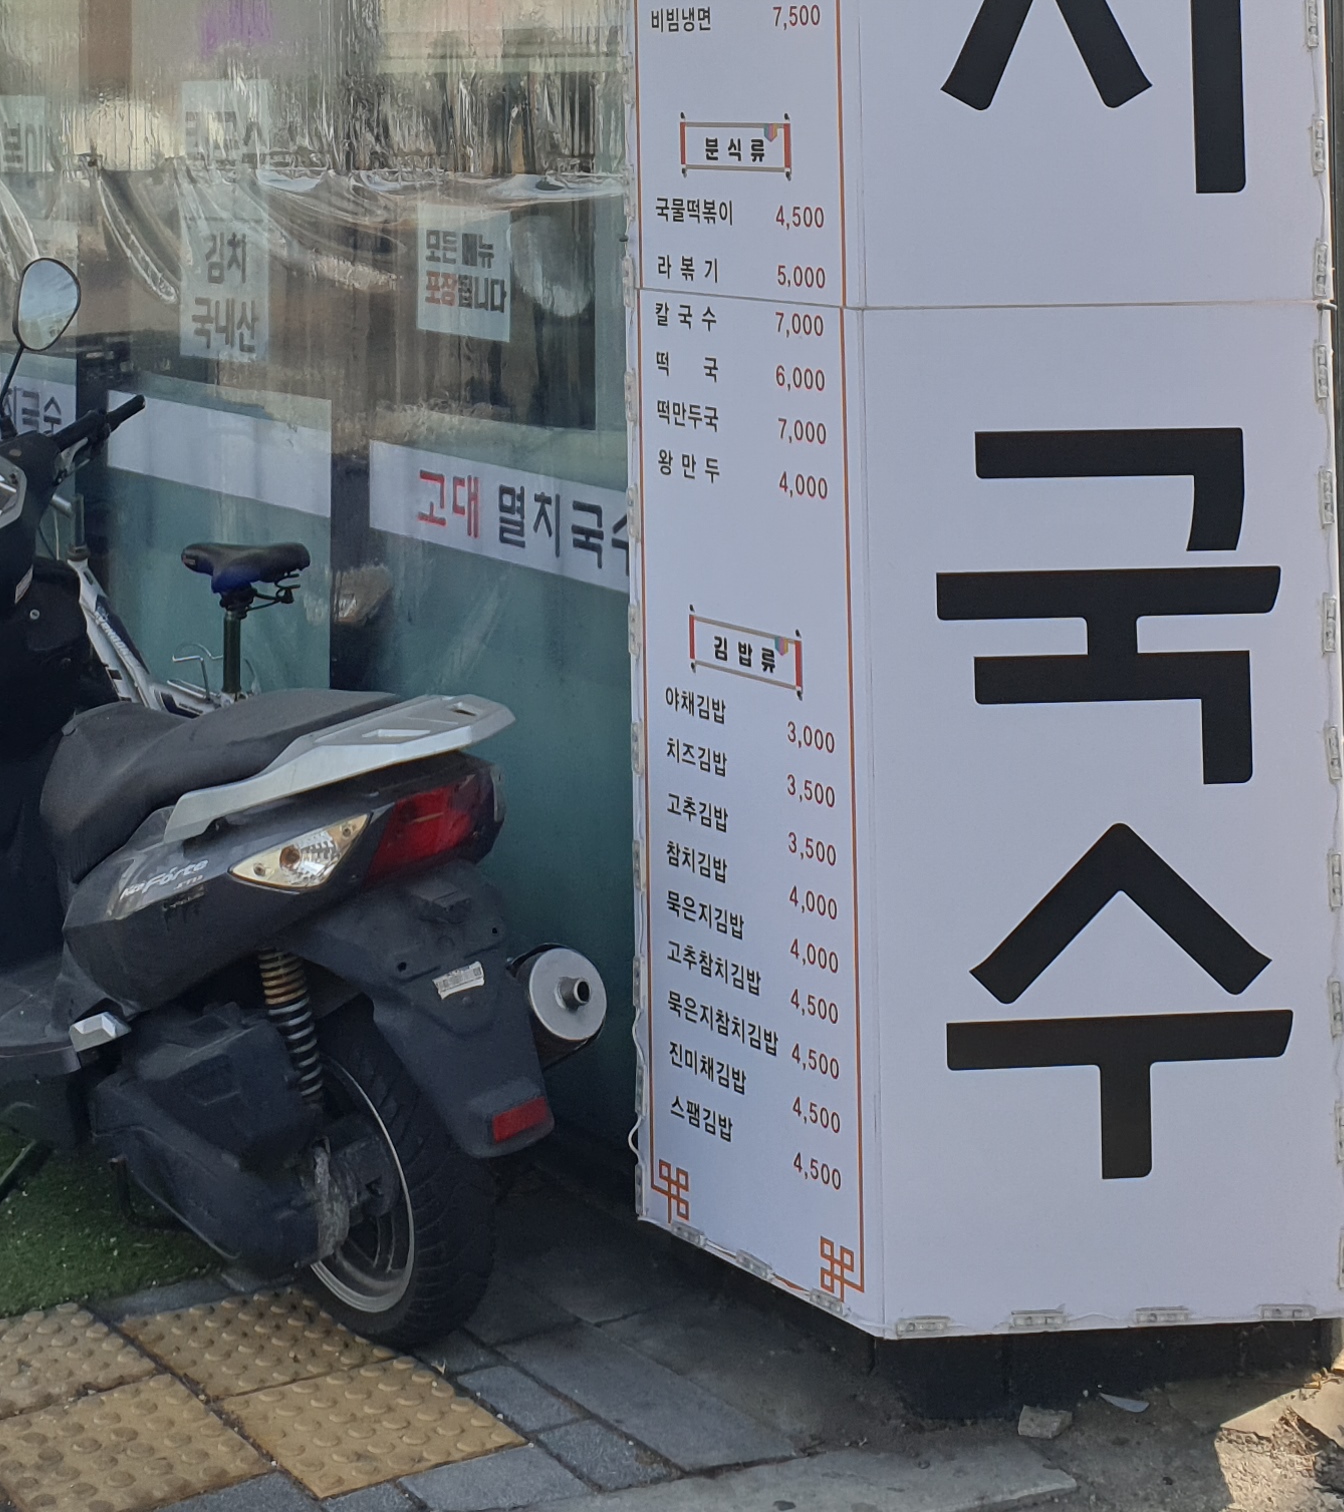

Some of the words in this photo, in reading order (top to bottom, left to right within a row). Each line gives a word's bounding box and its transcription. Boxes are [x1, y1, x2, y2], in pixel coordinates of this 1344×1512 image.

[651, 7, 711, 32] 비빔냉면
[772, 5, 820, 30] 7,500
[656, 198, 734, 226] 국물떡볶이
[776, 205, 824, 230] 4,500
[204, 233, 247, 284] 김치
[426, 229, 457, 264] 모든
[425, 271, 507, 314] 포장됩니다
[777, 265, 826, 289] 5,000
[191, 297, 259, 350] 국내산
[775, 312, 824, 338] 7,000
[776, 365, 825, 392] 6,000
[657, 400, 719, 433] 떡만두국
[778, 418, 827, 445] 7,000
[417, 469, 479, 539] 고대
[779, 472, 828, 500] 4,000
[665, 687, 726, 724] 야채김밥
[787, 721, 835, 754] 3,000
[667, 737, 727, 777] 치즈김밥
[787, 774, 835, 808] 3,500
[668, 793, 728, 833] 고추김밥
[788, 832, 836, 866] 3,500
[667, 841, 727, 883] 참치김밥
[789, 886, 838, 920] 4,000
[667, 890, 744, 940] 묵은지김밥
[790, 938, 839, 974] 4,000
[667, 940, 761, 996] 고추참치김밥
[790, 989, 839, 1025] 4,500
[668, 991, 778, 1057] 묵은지참치김밥
[791, 1044, 840, 1079] 4,500
[669, 1041, 746, 1095] 진미채김밥
[793, 1096, 841, 1134] 4,500
[671, 1096, 733, 1142] 스팸김밥
[793, 1152, 842, 1190] 4,500
